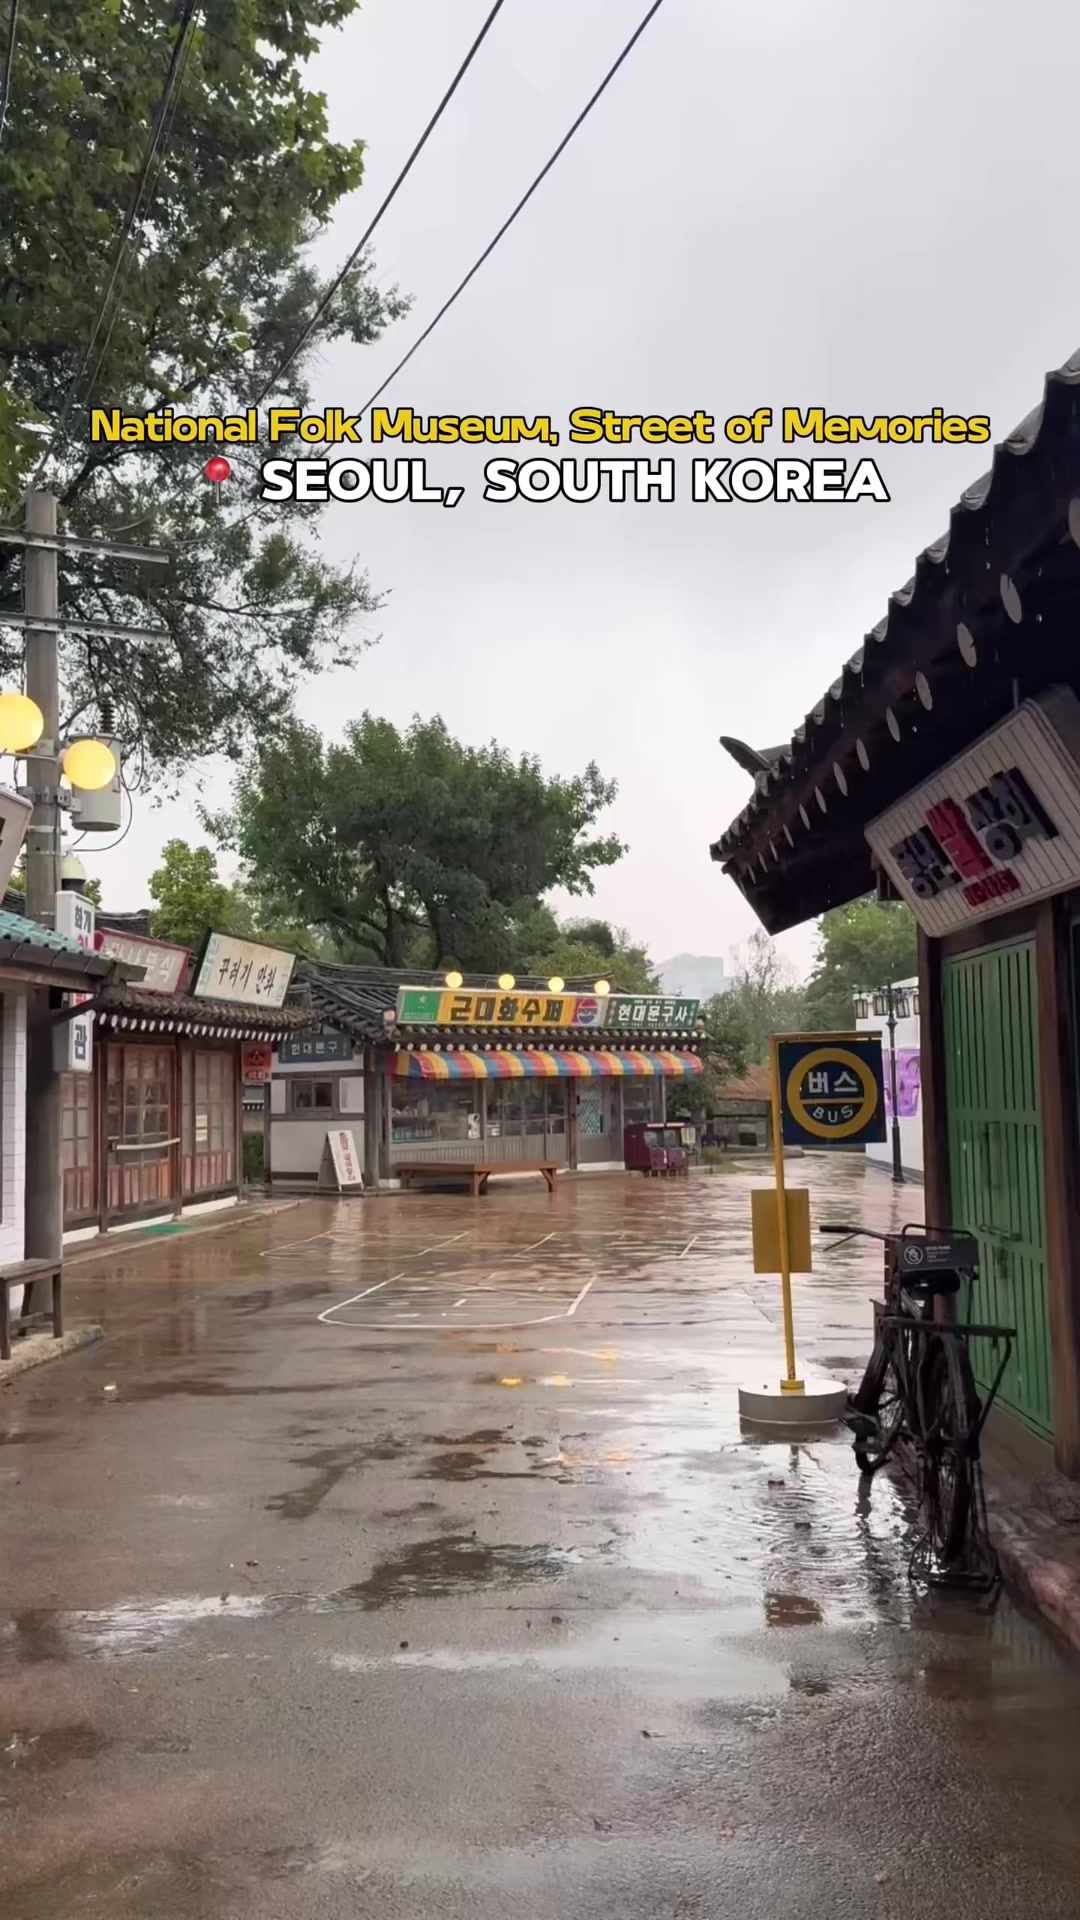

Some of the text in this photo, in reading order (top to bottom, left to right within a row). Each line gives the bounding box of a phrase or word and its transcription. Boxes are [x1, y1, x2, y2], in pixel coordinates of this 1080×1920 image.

[218, 957, 254, 992] 꾸러기
[450, 995, 564, 1023] 근대화수퍼
[618, 1003, 688, 1023] 현대문구사
[807, 1070, 858, 1094] 버스
[812, 1105, 854, 1123] BUS
